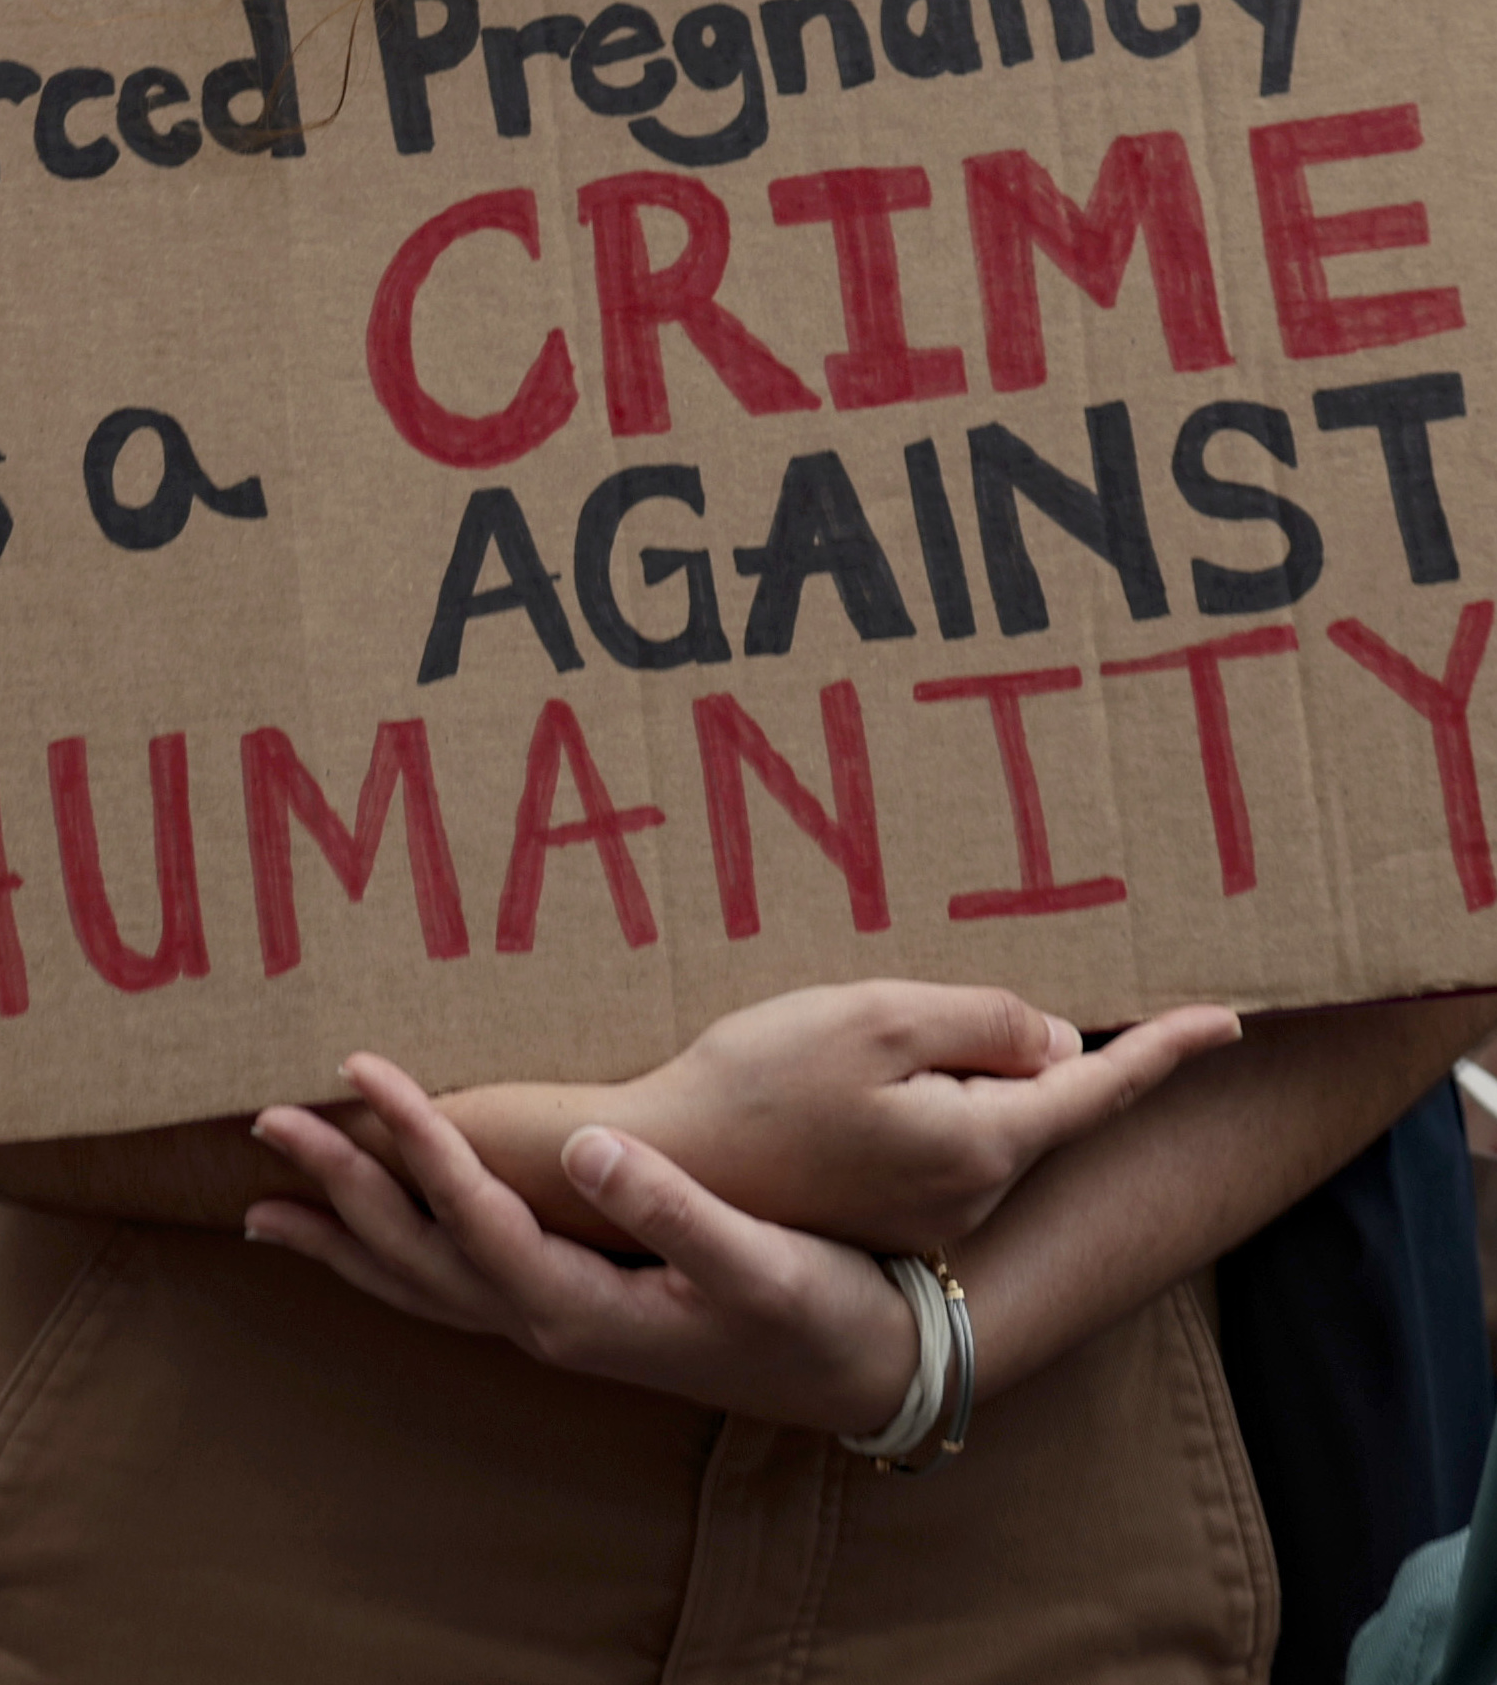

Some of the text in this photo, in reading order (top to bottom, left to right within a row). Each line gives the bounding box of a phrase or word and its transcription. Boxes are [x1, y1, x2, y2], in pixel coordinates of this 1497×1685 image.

[82, 407, 268, 551] a
[365, 103, 1465, 469] CRIME
[417, 372, 1466, 685] AGAINST
